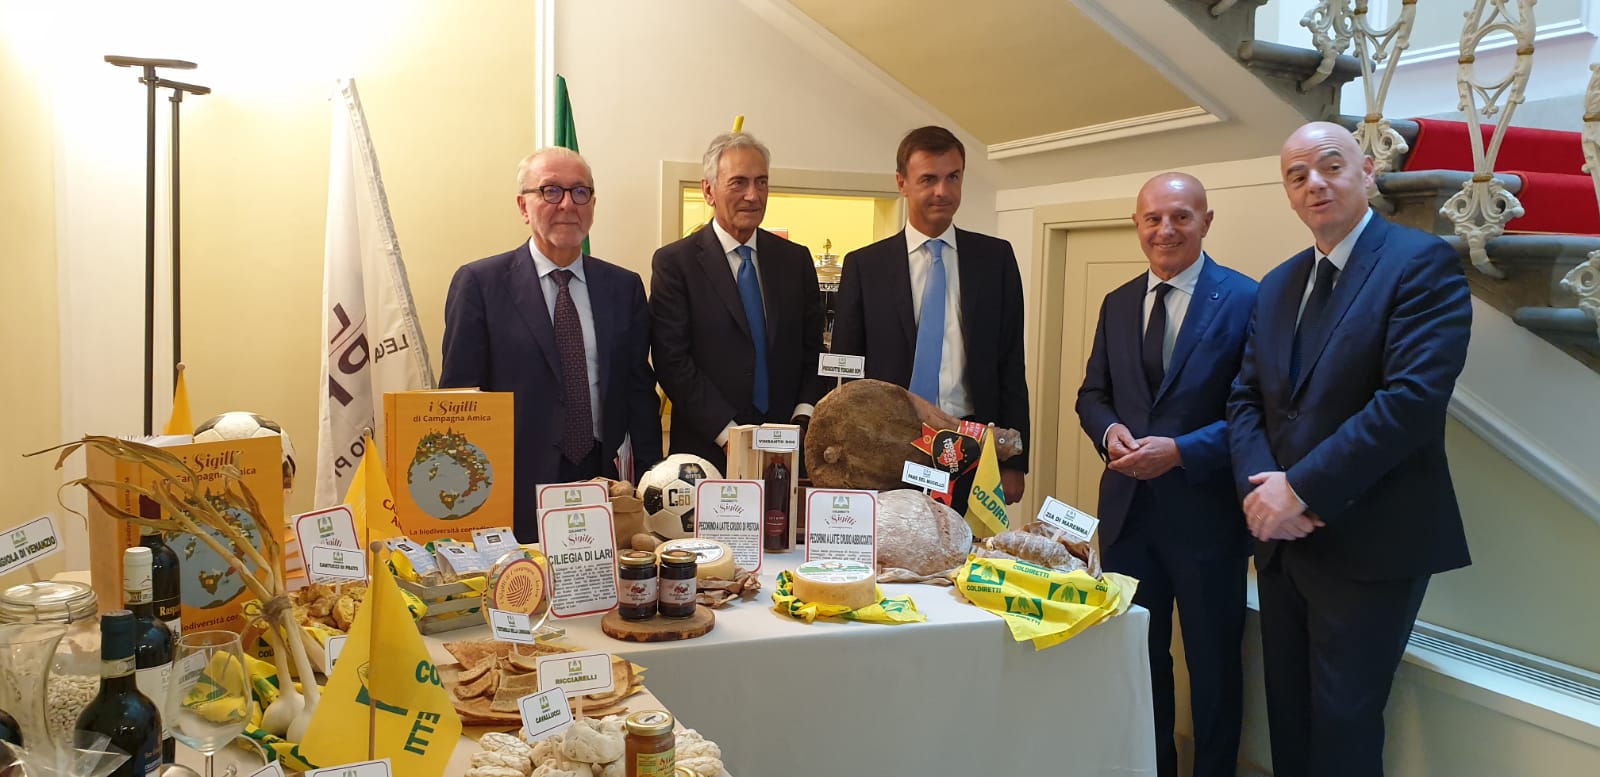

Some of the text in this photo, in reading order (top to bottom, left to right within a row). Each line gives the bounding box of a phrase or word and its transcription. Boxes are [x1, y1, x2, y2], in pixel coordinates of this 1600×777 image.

[428, 400, 478, 415] i Sigilli
[422, 415, 465, 424] Campagna
[466, 414, 492, 422] Amica
[1061, 519, 1089, 536] MAREMMA
[549, 548, 613, 565] CILIEGIA DI LARI
[1012, 564, 1050, 579] COLDIRETTI
[966, 584, 1002, 593] COLDIRETTI
[555, 674, 598, 685] RICCIARELLI
